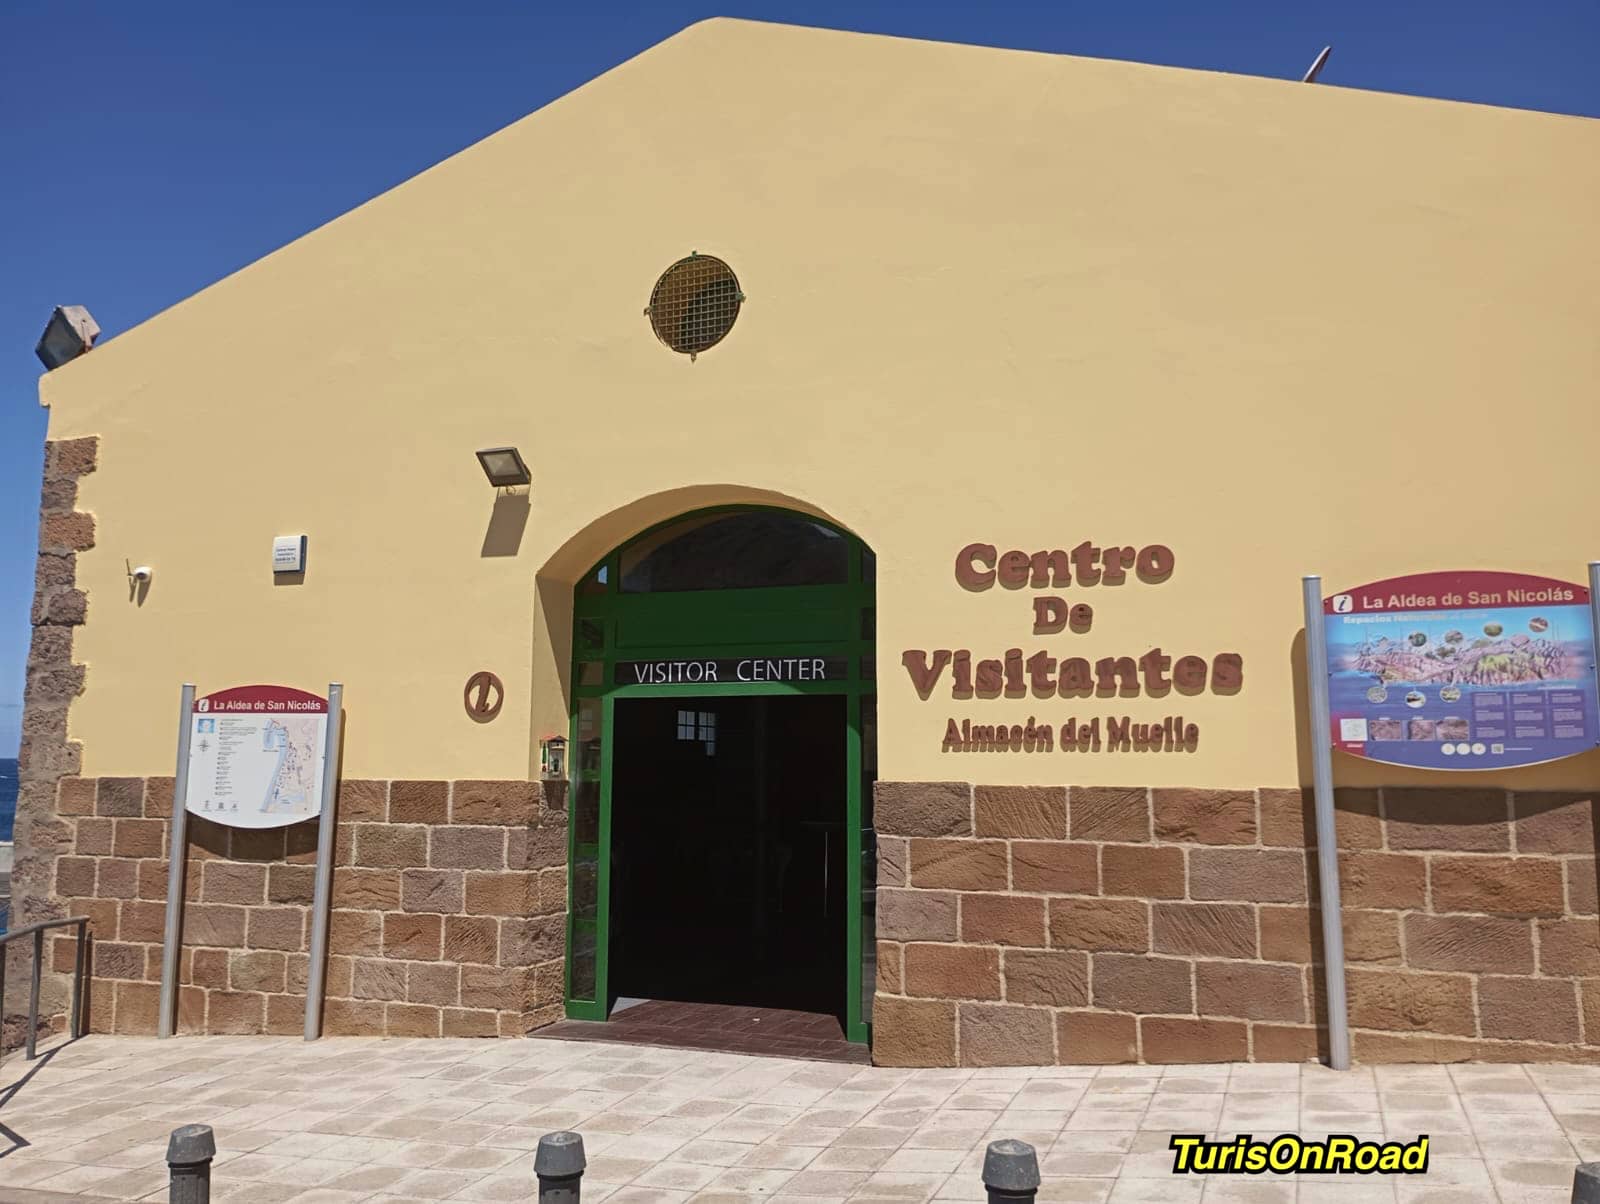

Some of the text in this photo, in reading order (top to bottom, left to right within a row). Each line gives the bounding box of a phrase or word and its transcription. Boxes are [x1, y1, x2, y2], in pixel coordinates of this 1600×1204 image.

[955, 541, 1175, 592] Centro
[1033, 596, 1093, 635] De
[1363, 587, 1575, 609] La Aldea de San Nicolás
[634, 659, 825, 683] VISITOR CENTER
[902, 648, 1244, 701] Visitantes
[213, 700, 321, 711] La Aldea de San Nicolás
[942, 716, 1199, 753] Almacén del Muelle
